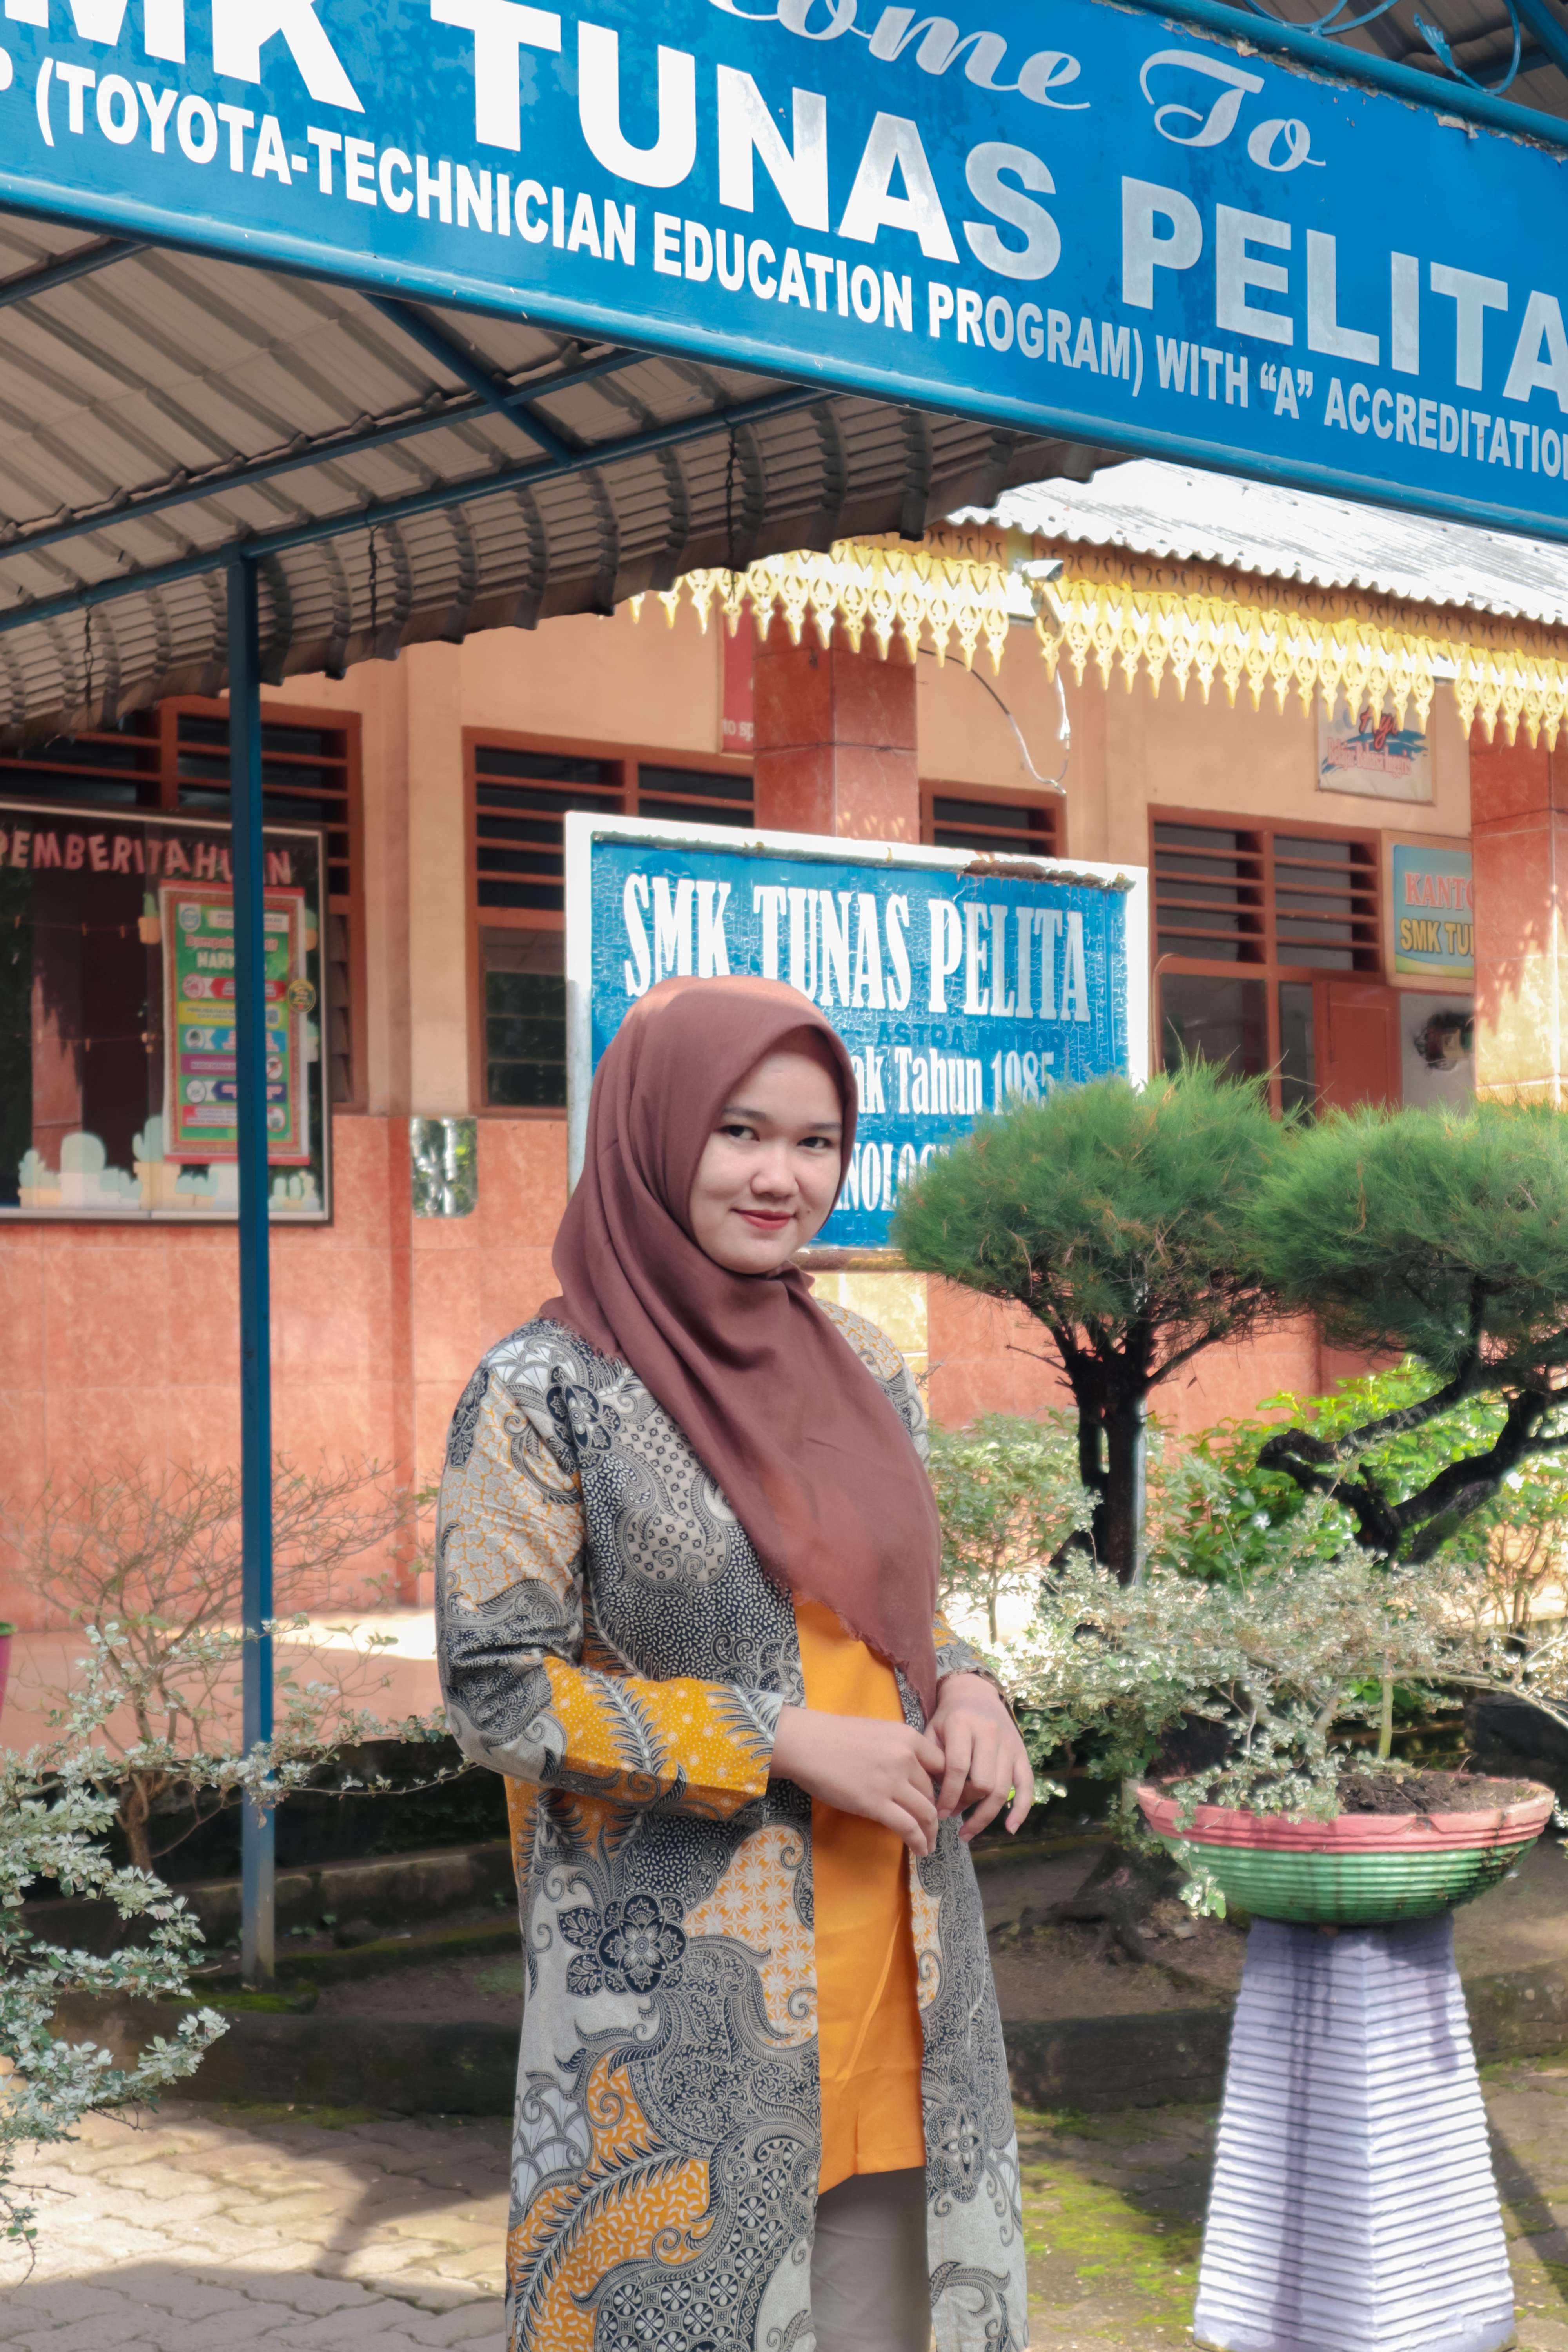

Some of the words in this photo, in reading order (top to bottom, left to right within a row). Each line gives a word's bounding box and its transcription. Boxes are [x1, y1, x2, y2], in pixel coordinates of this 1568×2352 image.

[1139, 49, 1326, 172] To
[36, 56, 636, 266] (TOYOTA-TECHNICIAN
[653, 211, 913, 332] EDUCATION
[928, 281, 1144, 397] PROGRAM)
[1156, 334, 1249, 408] WITH
[430, 0, 1061, 280] TUNAS
[1121, 175, 1568, 415] PELITA
[0, 829, 292, 885] EMBERITAHUN
[623, 873, 731, 998] SMK
[753, 886, 911, 1012] TUNAS
[928, 898, 1091, 1022] PELITA
[1400, 917, 1442, 954] SMK
[894, 1047, 983, 1115] Tahun
